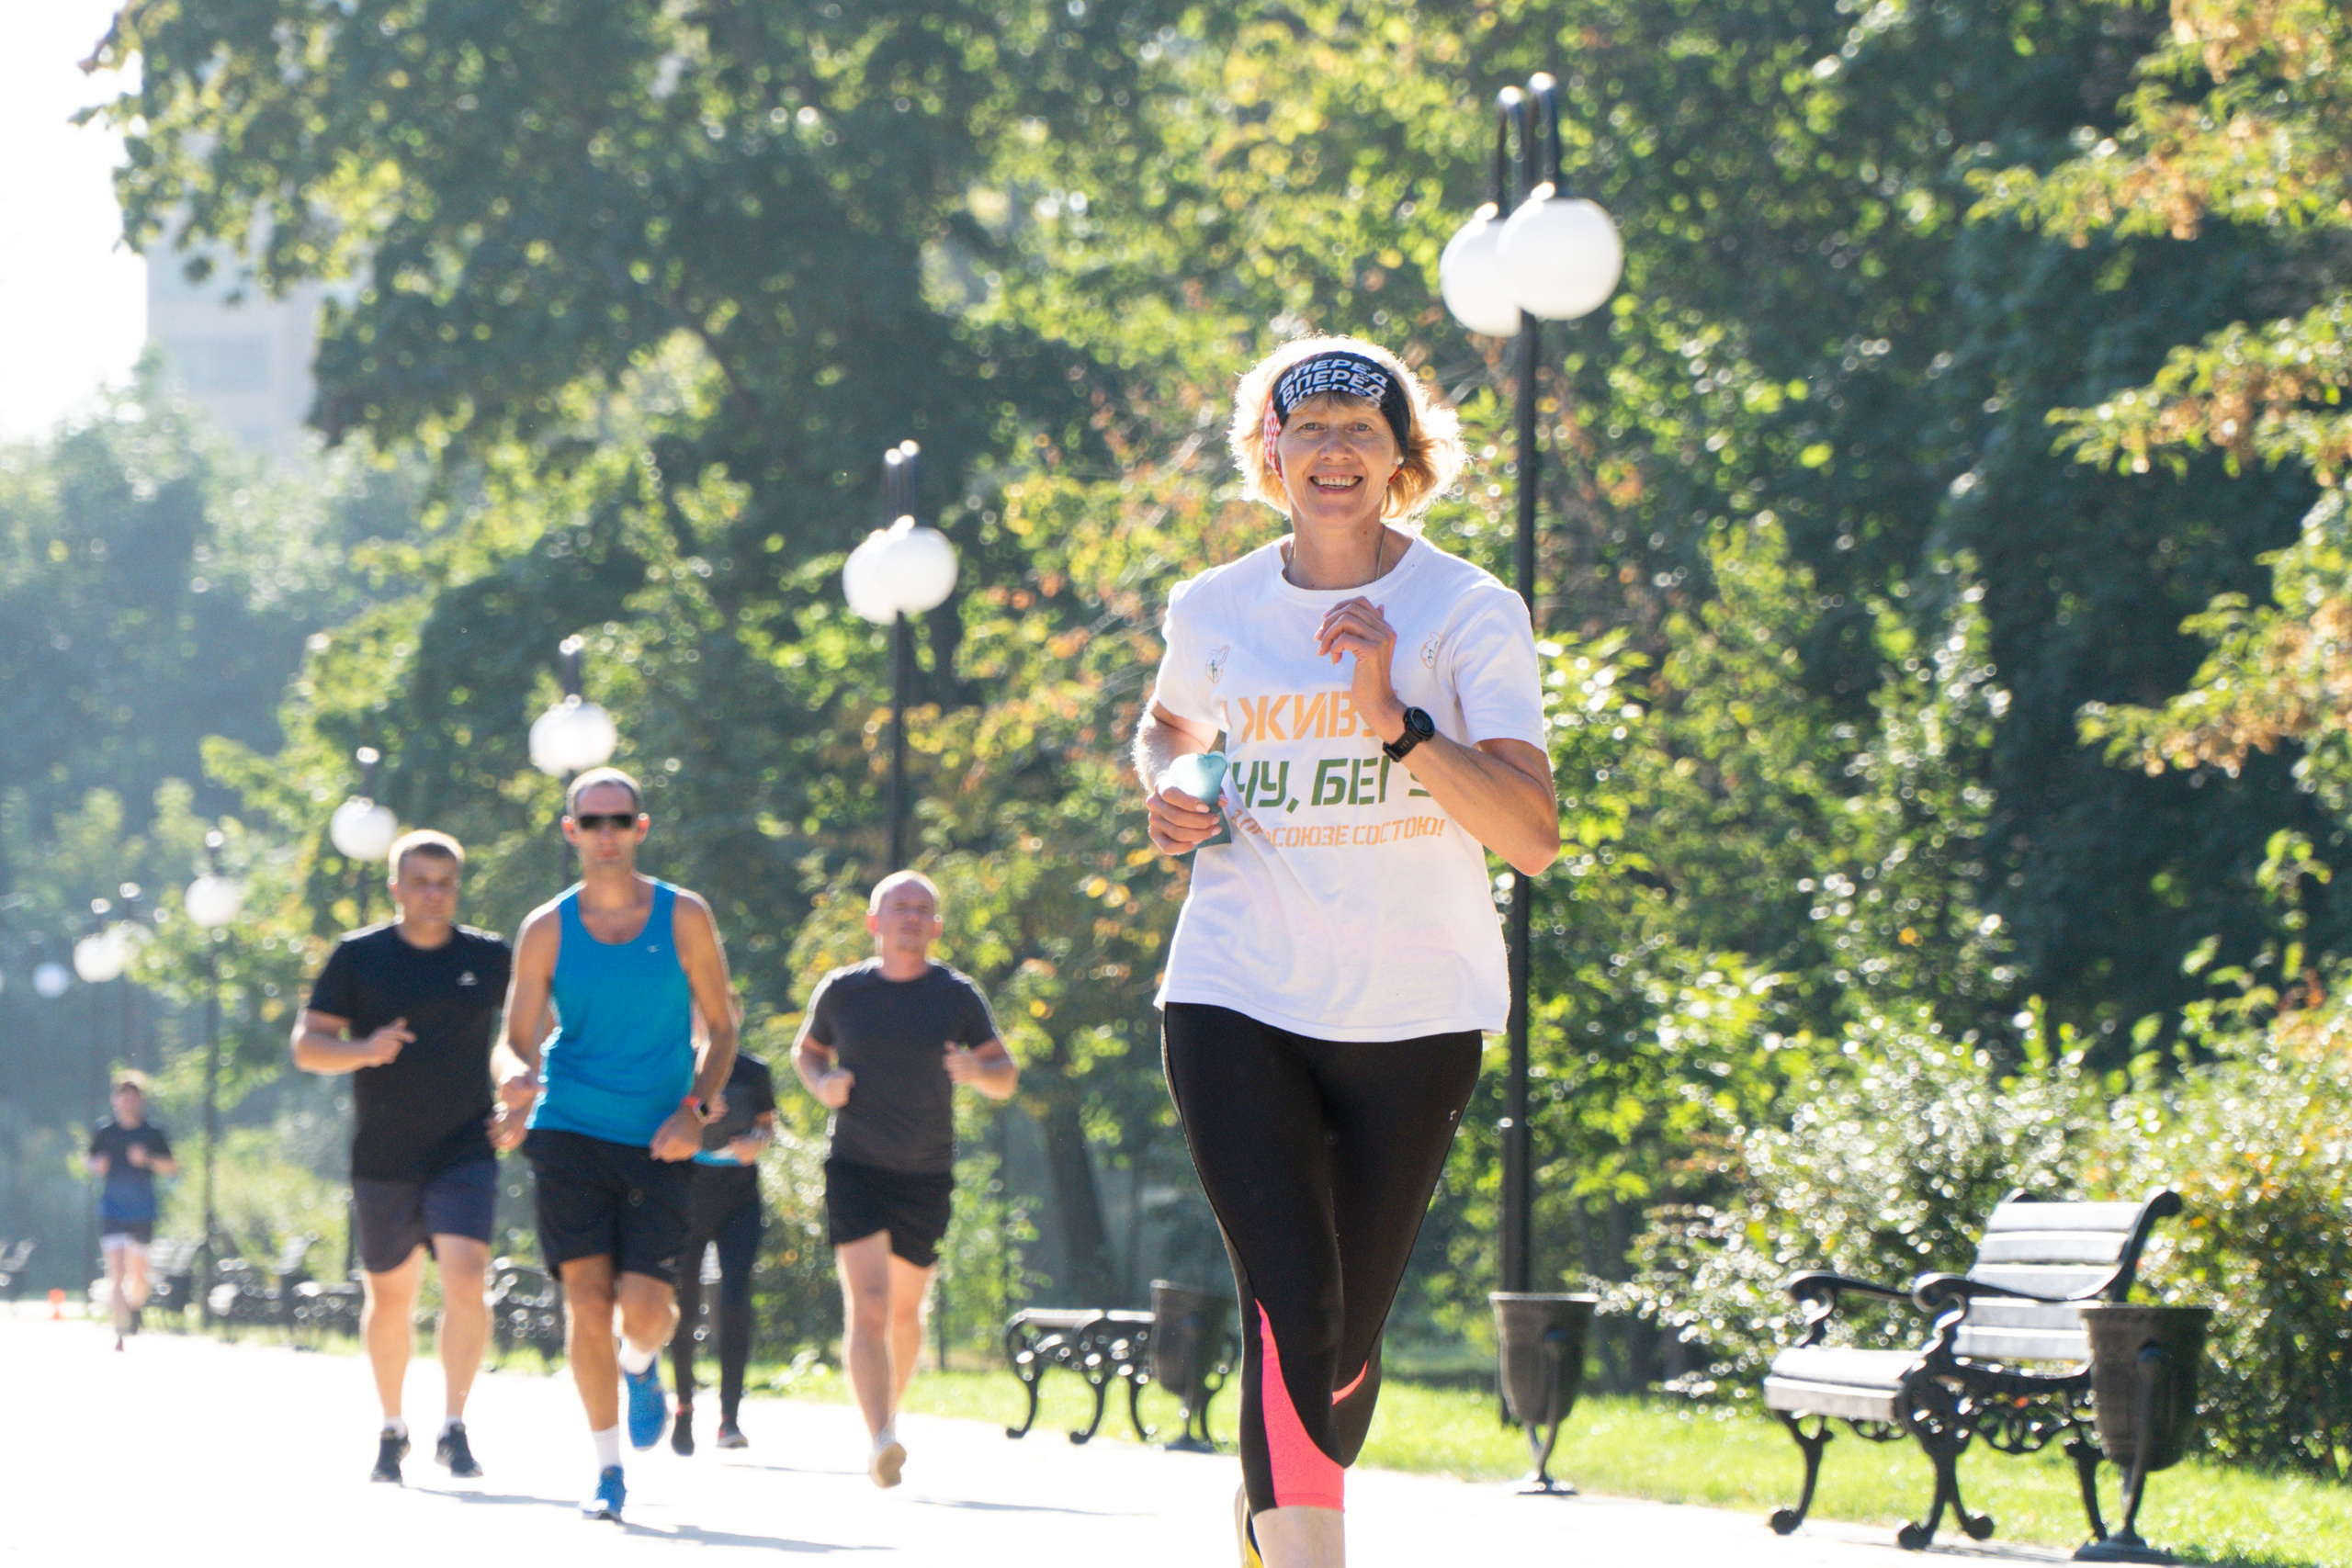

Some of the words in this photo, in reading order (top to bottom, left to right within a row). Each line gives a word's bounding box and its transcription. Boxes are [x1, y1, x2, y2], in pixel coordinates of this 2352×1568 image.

[1283, 369, 1386, 406] ВПЕРЁД
[1238, 691, 1376, 743] ЖИВ
[1228, 760, 1300, 814] ЧУ,
[1310, 755, 1431, 807] БЕГ
[1351, 816, 1445, 846] СОСТОЮ!
